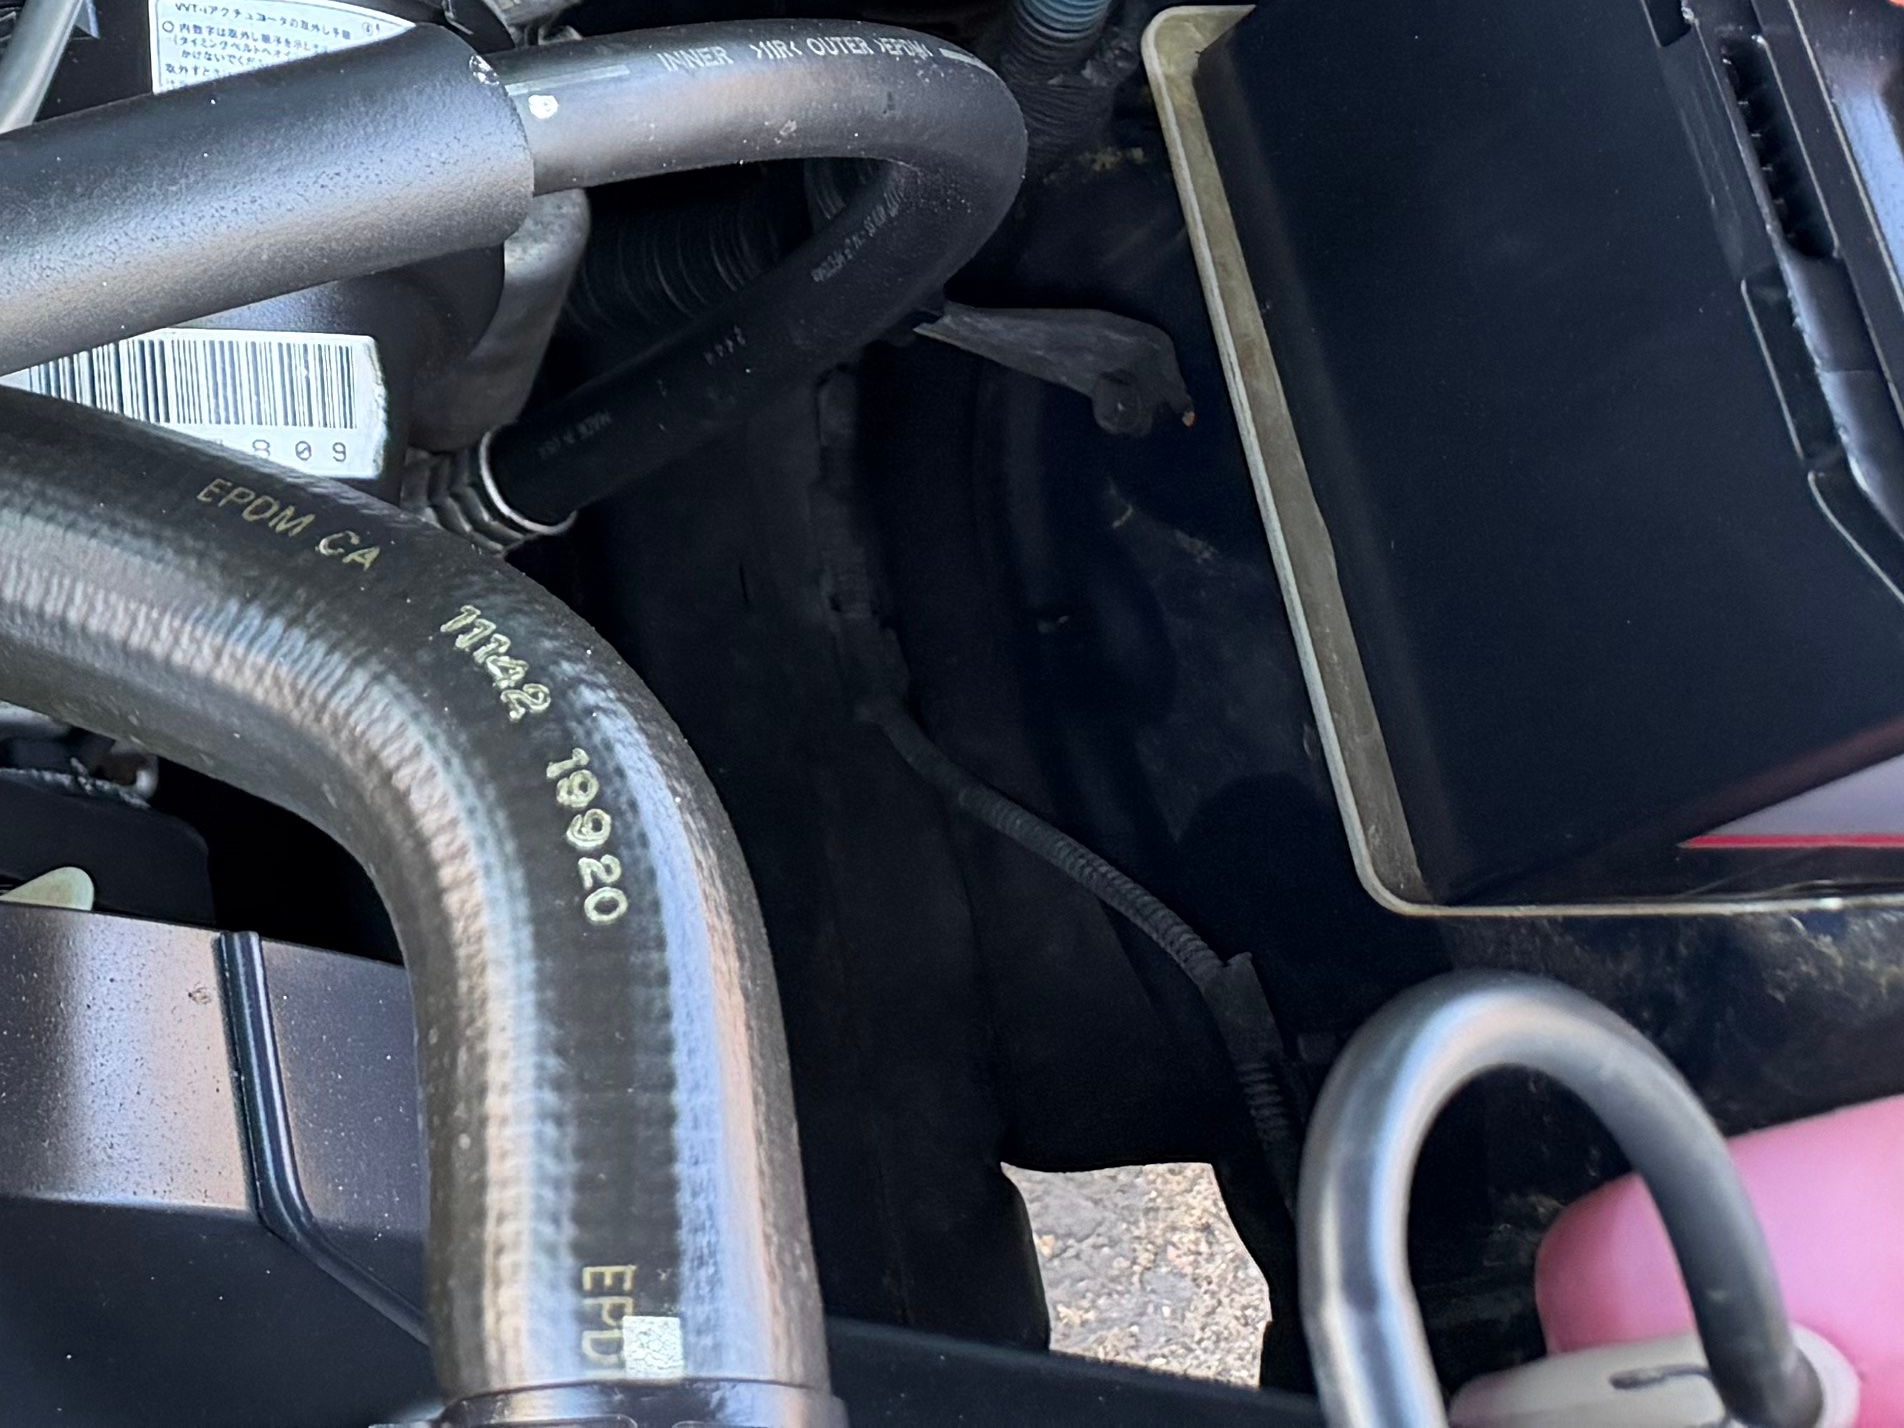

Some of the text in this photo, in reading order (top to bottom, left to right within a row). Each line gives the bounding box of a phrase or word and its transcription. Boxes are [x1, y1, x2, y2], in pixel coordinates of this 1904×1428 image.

[656, 45, 735, 73] INNER
[805, 36, 875, 57] OUTER
[196, 477, 381, 572] EPDM CA
[546, 747, 629, 926] 19920
[581, 1263, 638, 1380] EPD
